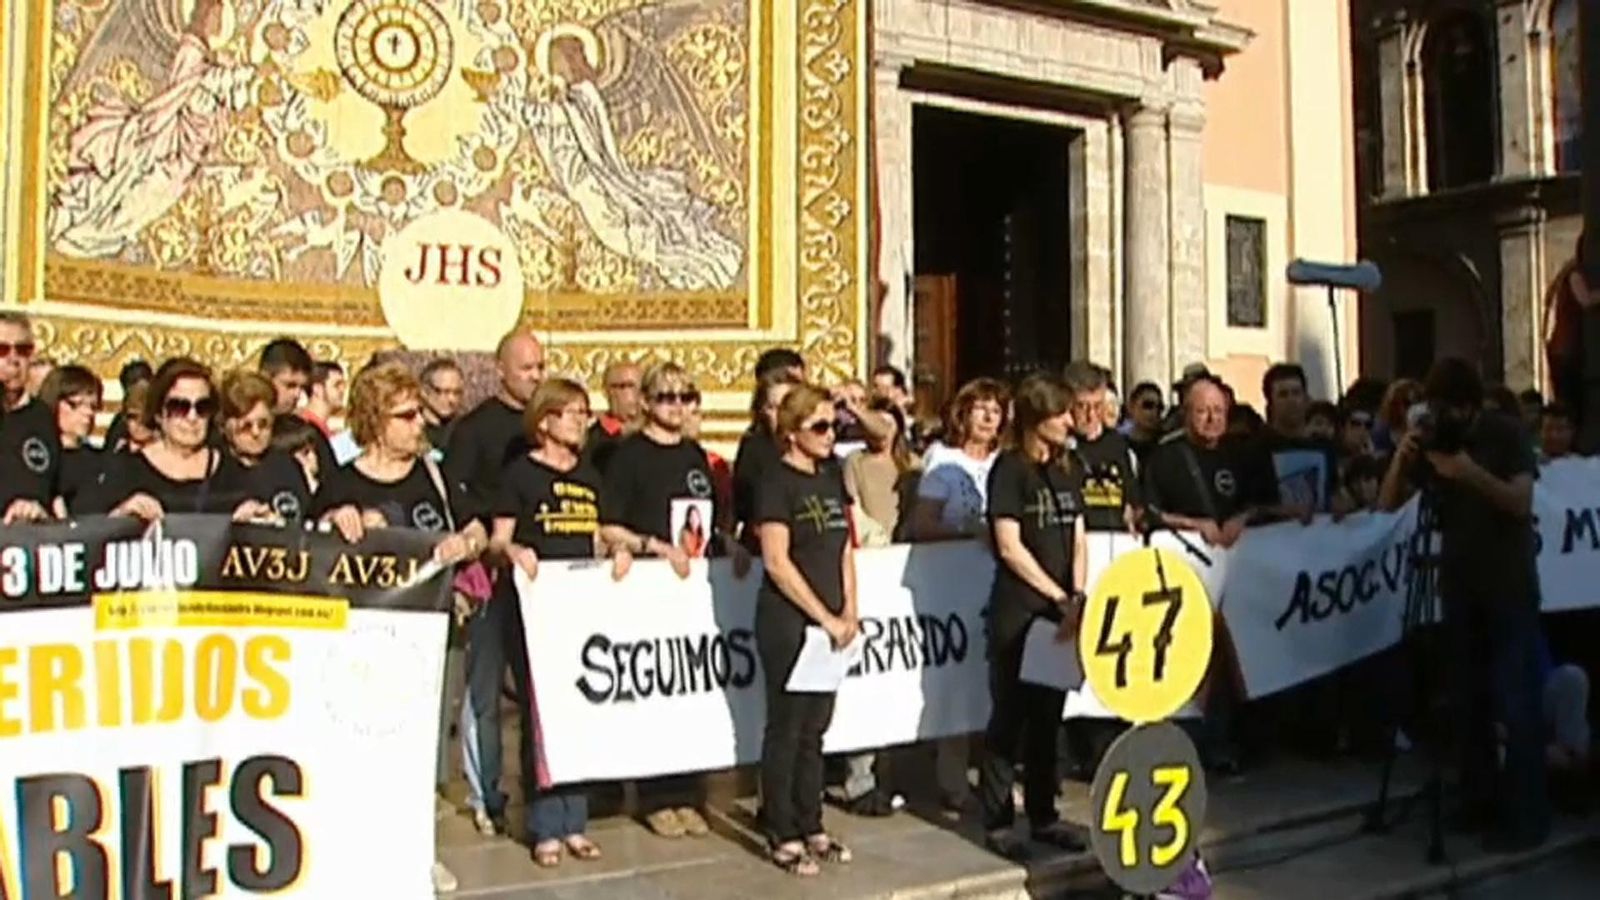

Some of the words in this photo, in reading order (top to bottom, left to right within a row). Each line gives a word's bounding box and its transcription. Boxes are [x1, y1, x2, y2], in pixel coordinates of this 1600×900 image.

[403, 242, 502, 287] JHS
[1562, 507, 1600, 554] M
[1, 545, 29, 597] 3
[38, 541, 85, 594] DE
[221, 546, 310, 582] AV3J
[328, 553, 418, 589] AV3J
[575, 627, 756, 704] SEGUIMOS
[1094, 586, 1183, 689] 47
[0, 753, 306, 900] BLES
[1101, 765, 1191, 867] 43
